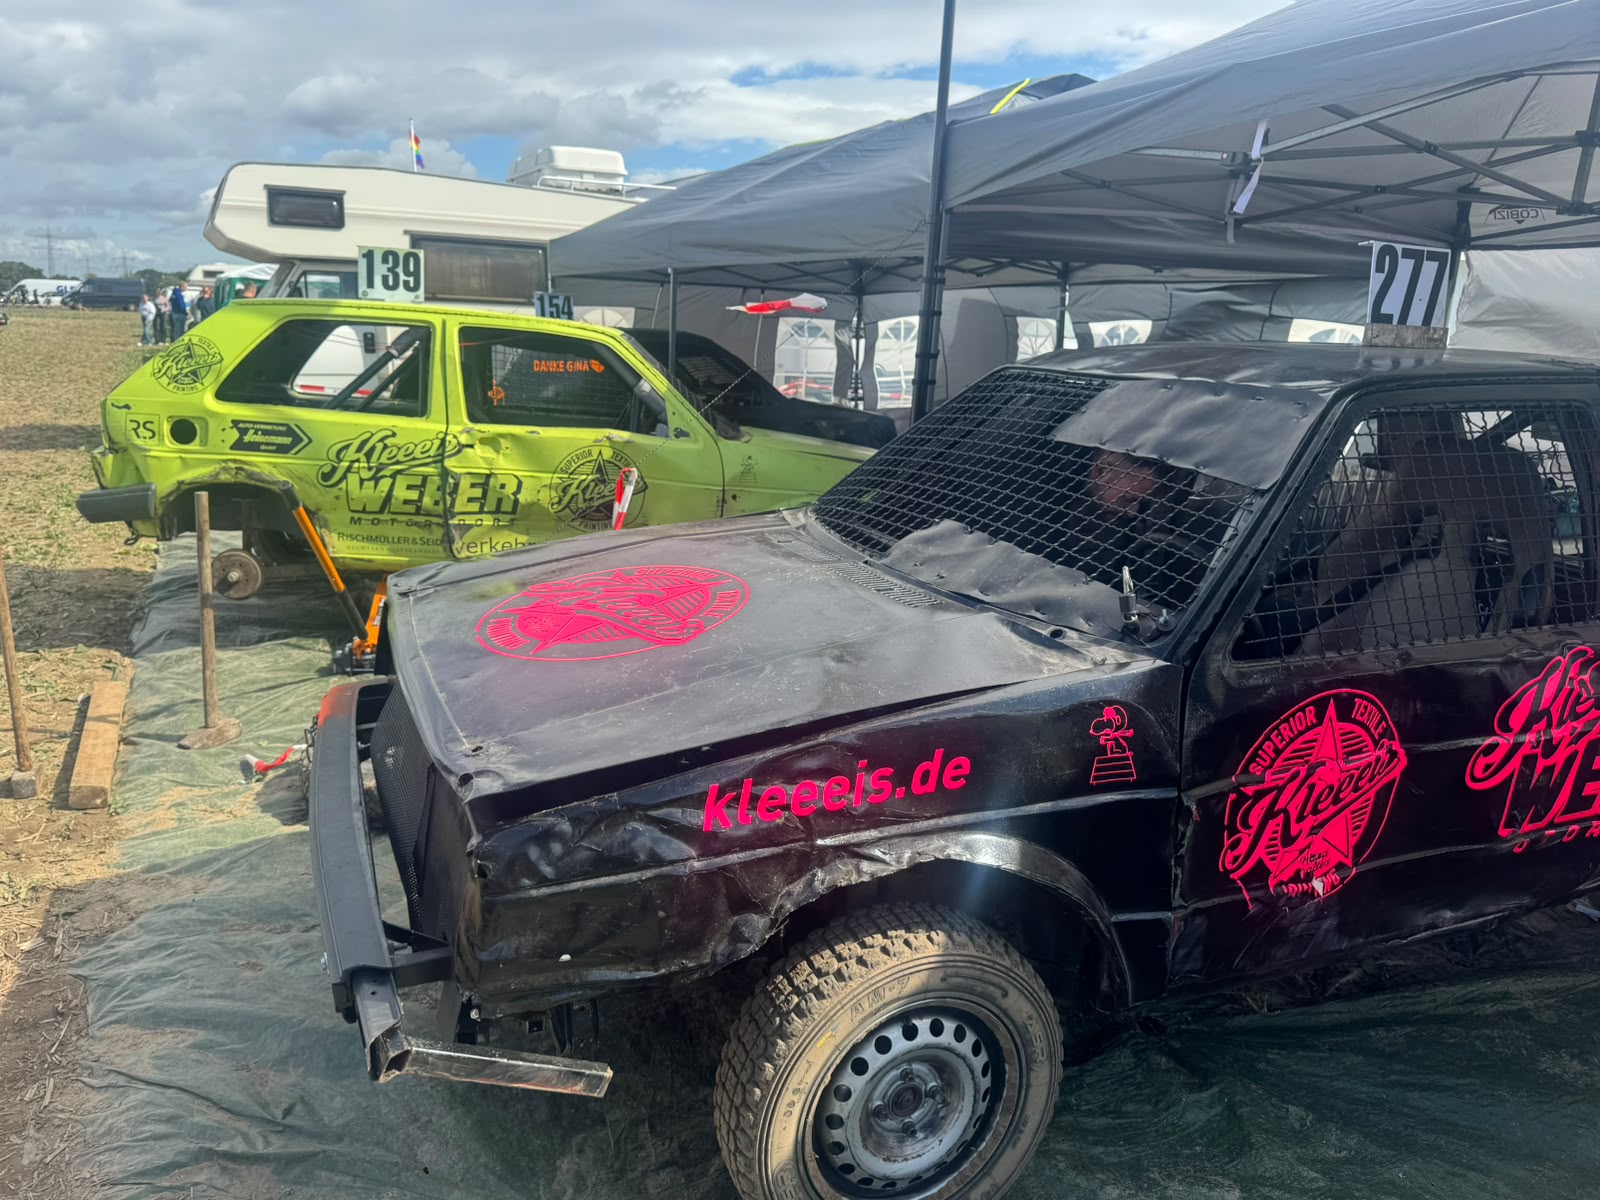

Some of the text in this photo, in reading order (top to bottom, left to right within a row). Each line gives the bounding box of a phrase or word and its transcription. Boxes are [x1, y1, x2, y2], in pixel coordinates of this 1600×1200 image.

[362, 249, 421, 293] 139
[1371, 244, 1449, 326] 277
[536, 293, 573, 320] 154
[533, 360, 565, 372] DANKE
[129, 419, 156, 440] RS
[560, 448, 593, 474] SUPERIOR
[346, 472, 522, 516] WEBER
[1249, 698, 1388, 776] SUPERIOR TEXTILE
[702, 748, 971, 831] kleeeis.de
